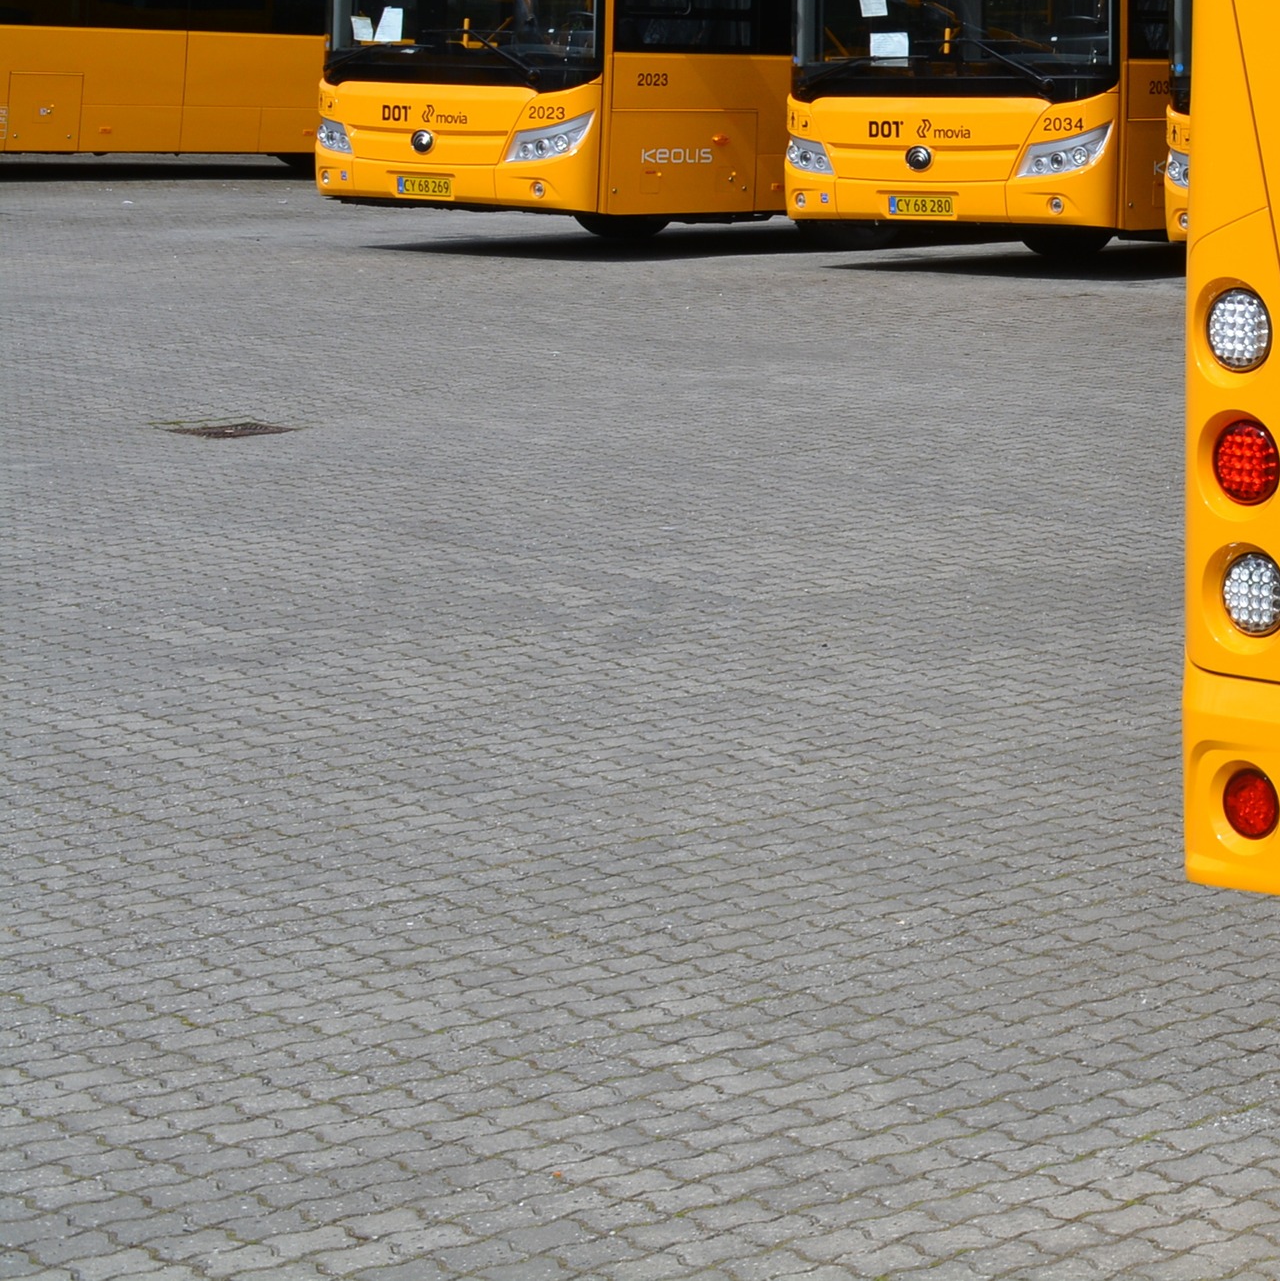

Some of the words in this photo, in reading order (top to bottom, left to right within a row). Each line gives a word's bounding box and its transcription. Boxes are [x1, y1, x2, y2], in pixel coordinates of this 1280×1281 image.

[637, 72, 669, 87] 2023
[382, 104, 412, 122] DOT
[435, 111, 468, 124] movia
[528, 105, 566, 120] 2023
[868, 120, 904, 138] DOT
[933, 125, 971, 139] movia
[1043, 117, 1084, 132] 2034
[404, 179, 416, 192] CY
[418, 180, 430, 193] 68
[431, 180, 449, 194] 269
[896, 199, 911, 213] CY
[913, 199, 928, 213] 68
[929, 199, 951, 213] 280
